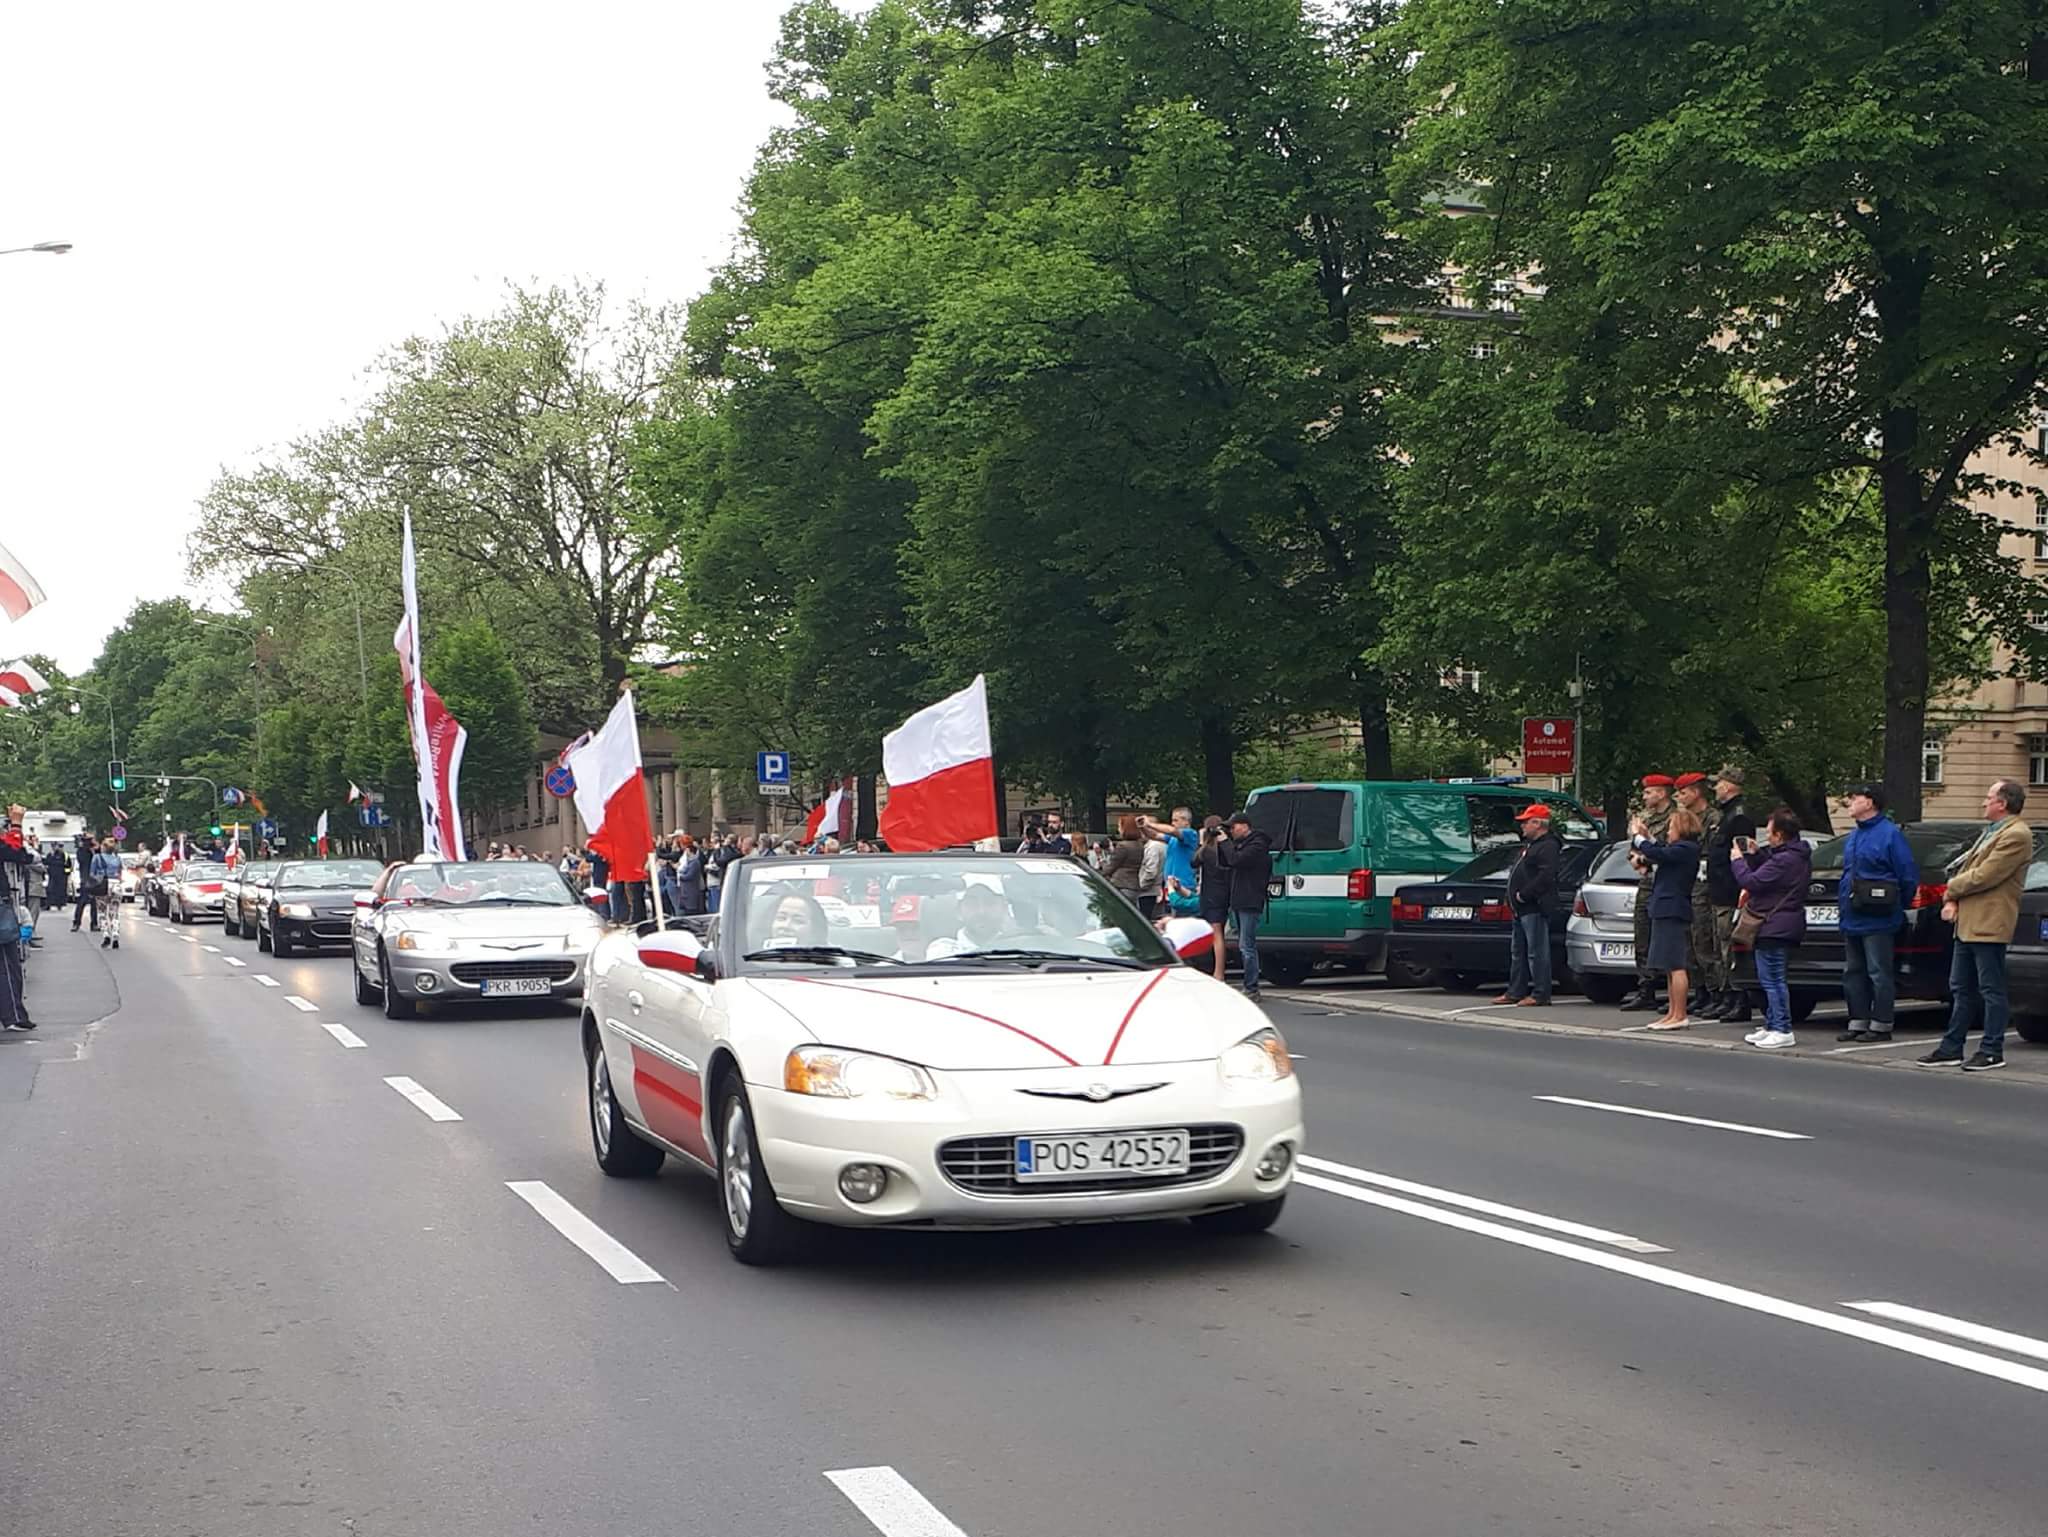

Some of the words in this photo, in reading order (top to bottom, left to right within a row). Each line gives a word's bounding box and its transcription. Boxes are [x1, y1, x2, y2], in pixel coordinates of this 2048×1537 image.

[1532, 737, 1567, 745] Automat
[1527, 749, 1571, 758] parkingowy
[764, 754, 783, 780] P
[1606, 943, 1621, 956] PO
[488, 981, 511, 992] PKR
[515, 980, 549, 991] 19055
[1034, 1141, 1091, 1173] POS
[1100, 1136, 1182, 1169] 42552
